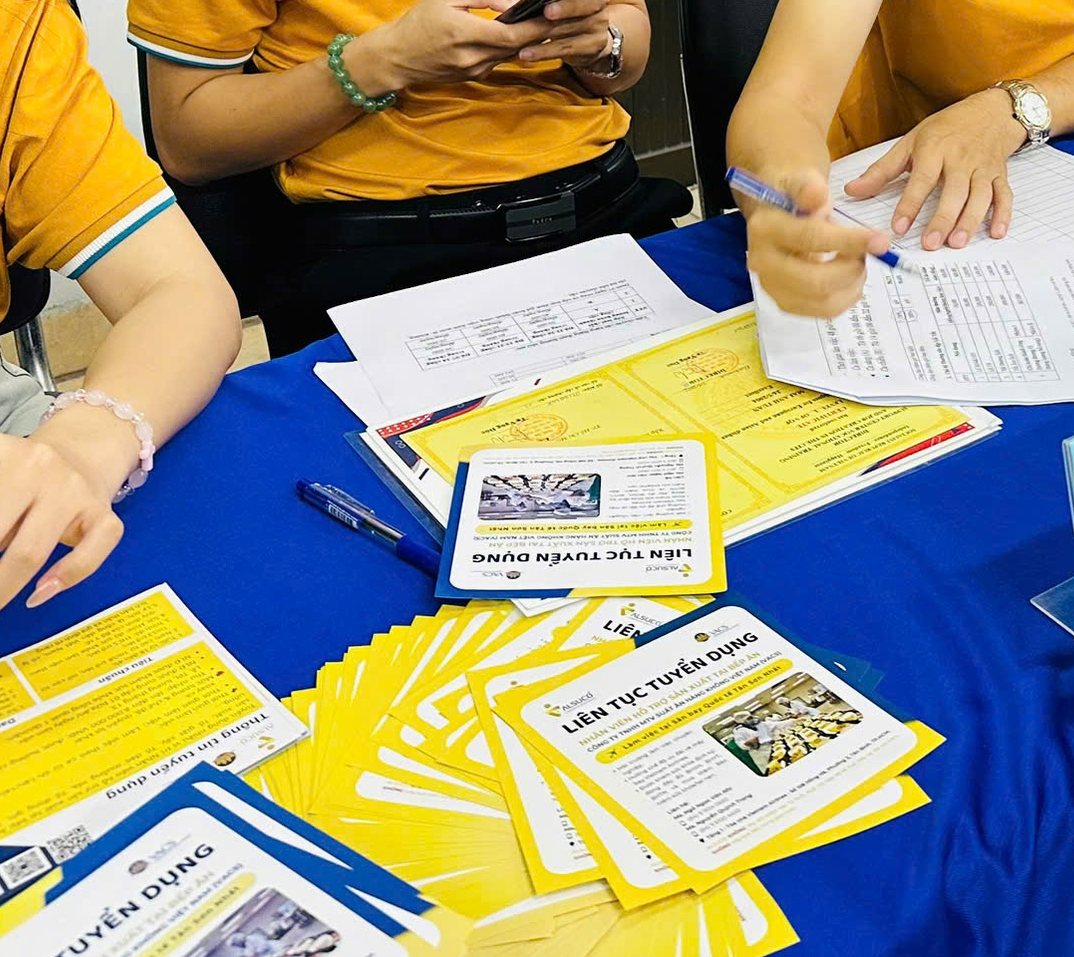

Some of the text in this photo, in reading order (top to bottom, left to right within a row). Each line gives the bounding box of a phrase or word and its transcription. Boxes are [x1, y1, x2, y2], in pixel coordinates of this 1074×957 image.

[471, 546, 692, 567] LIÊN TỤC TUYỂN DỤNG
[562, 633, 758, 733] LIÊN TỤC TUYỂN DỤNG
[106, 714, 267, 799] Thông tin tuyển dụng
[142, 844, 213, 899] DỤNG
